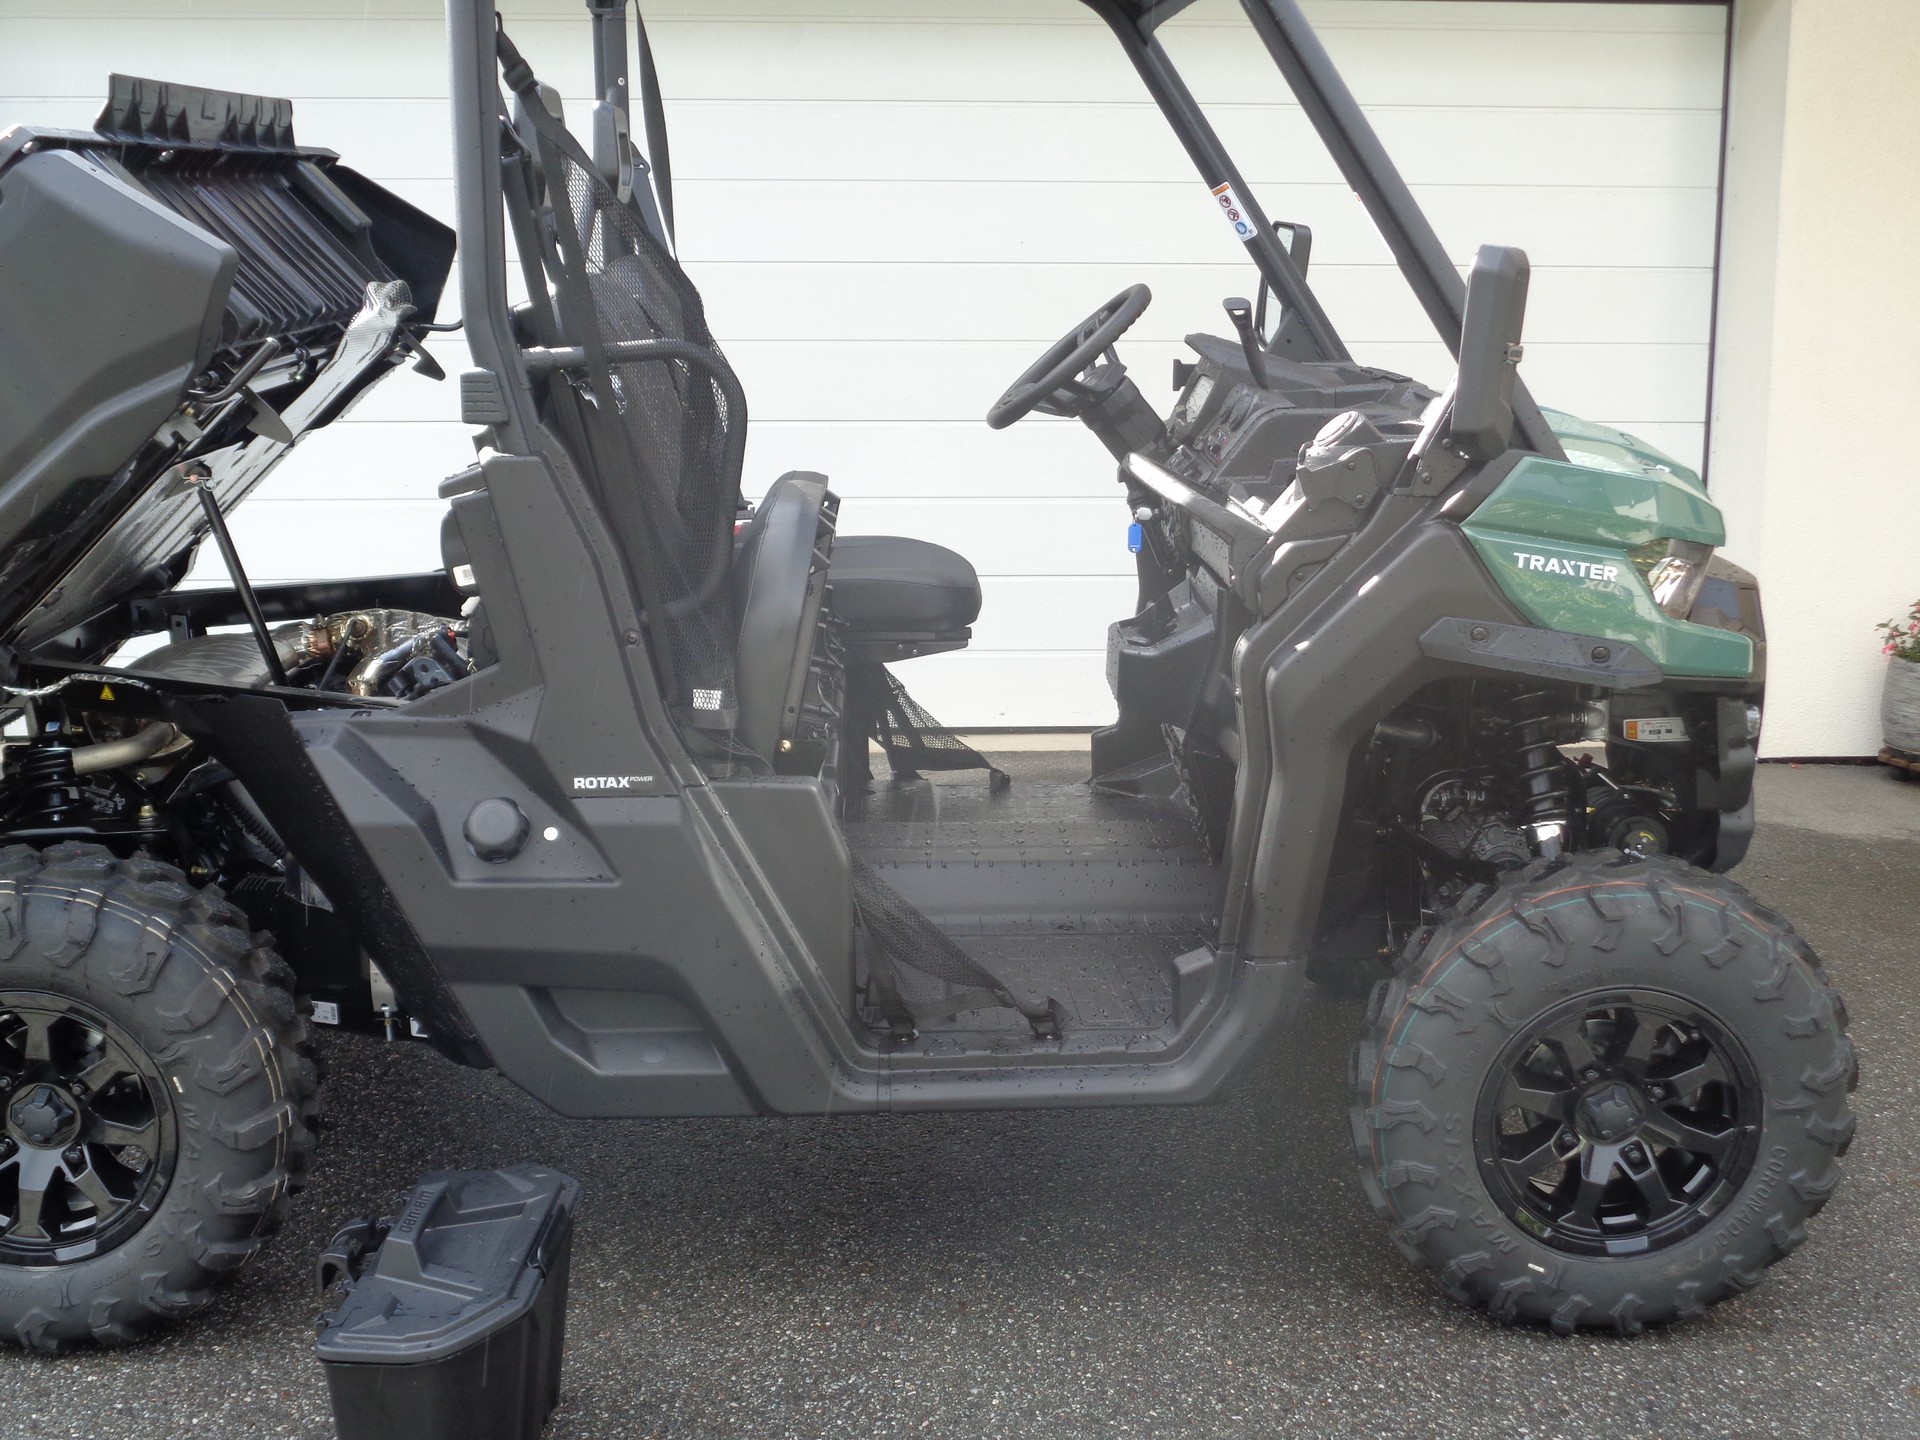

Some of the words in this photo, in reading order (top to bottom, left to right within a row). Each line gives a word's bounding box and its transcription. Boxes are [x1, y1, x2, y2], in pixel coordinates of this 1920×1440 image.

[1513, 552, 1618, 581] TRAXTER
[573, 776, 630, 789] ROTAX
[1443, 1112, 1519, 1254] MAXXIS
[1716, 1145, 1788, 1247] CORONADO
